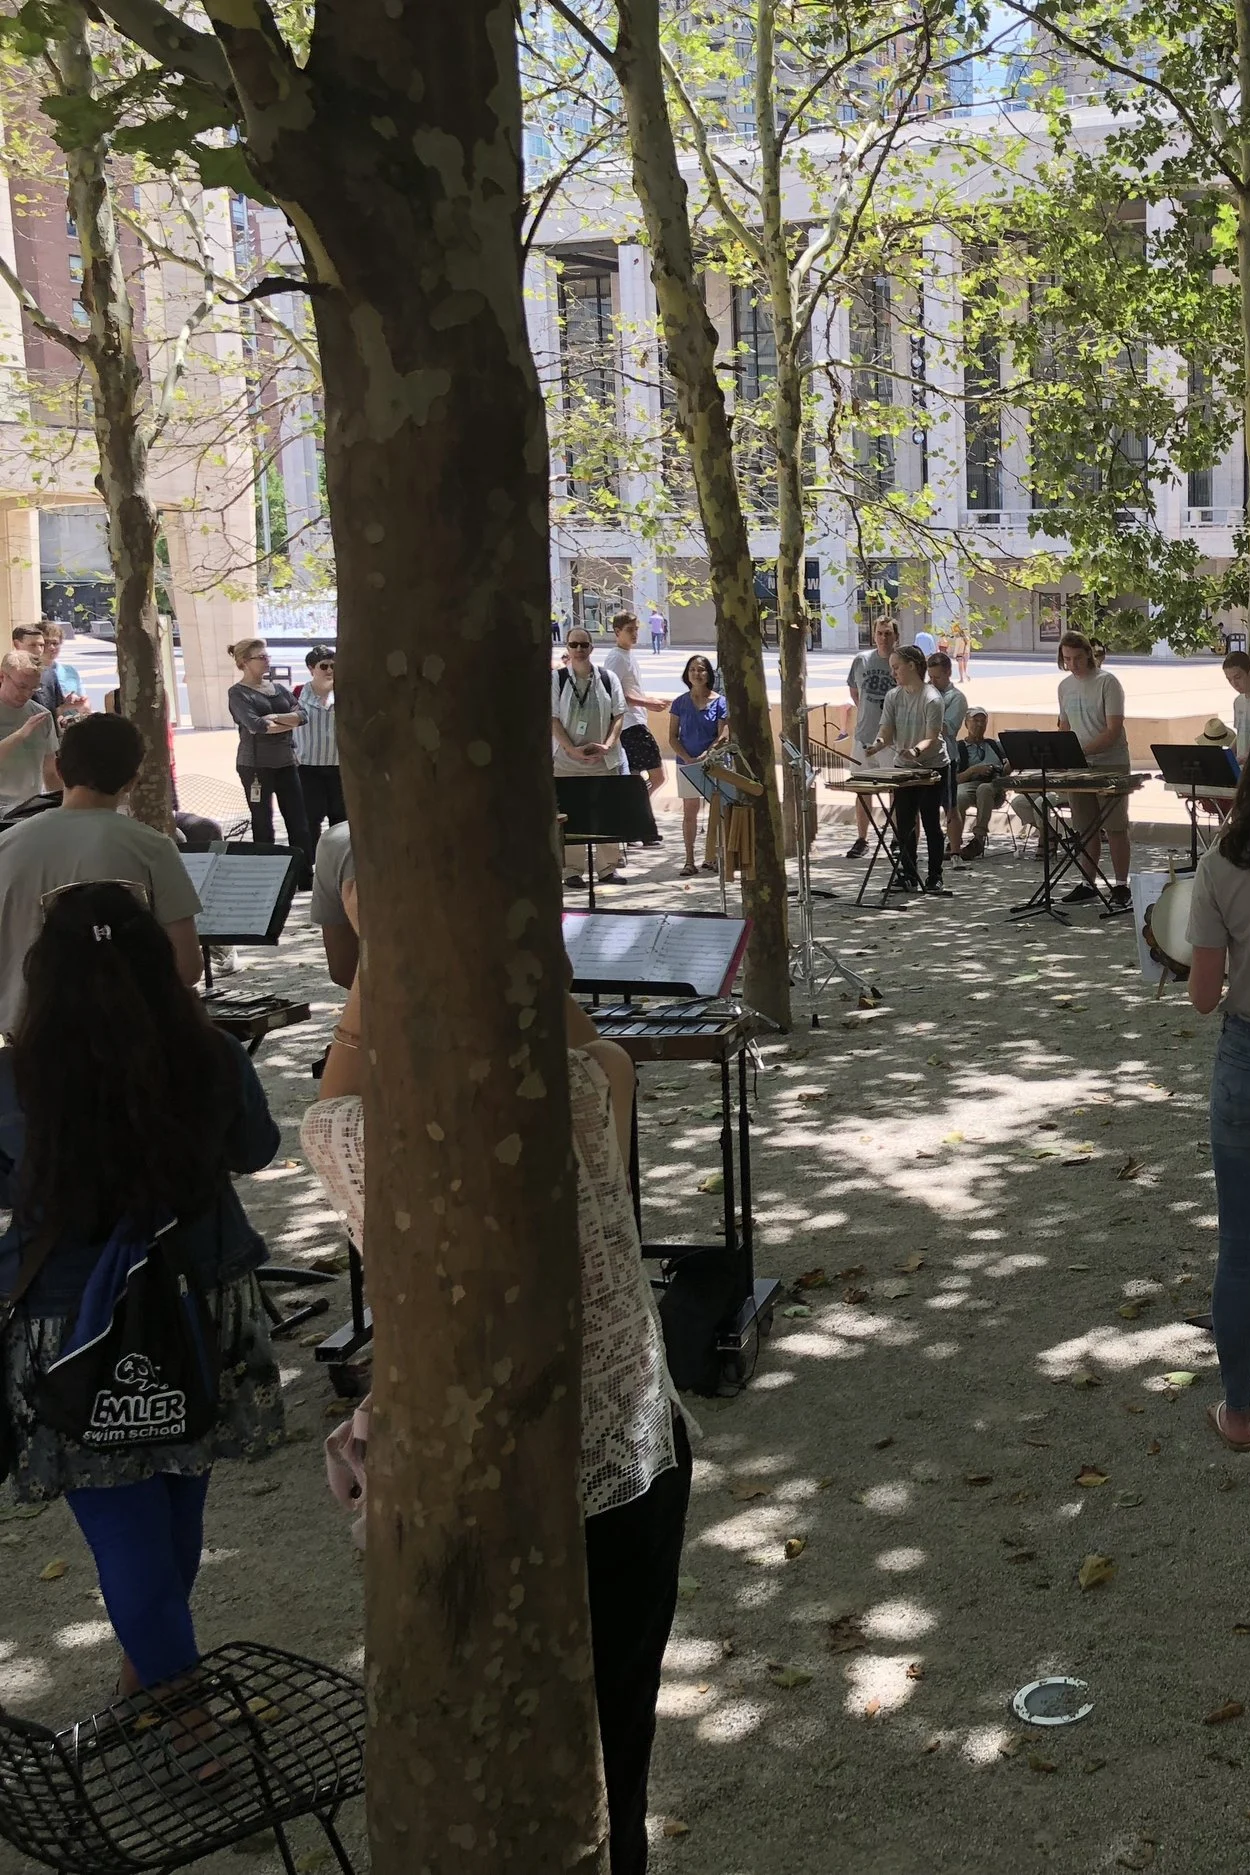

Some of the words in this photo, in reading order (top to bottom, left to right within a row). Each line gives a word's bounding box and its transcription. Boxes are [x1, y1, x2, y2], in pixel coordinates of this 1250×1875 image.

[91, 1390, 186, 1427] EMLER
[83, 1428, 125, 1441] swim
[128, 1420, 185, 1438] school
